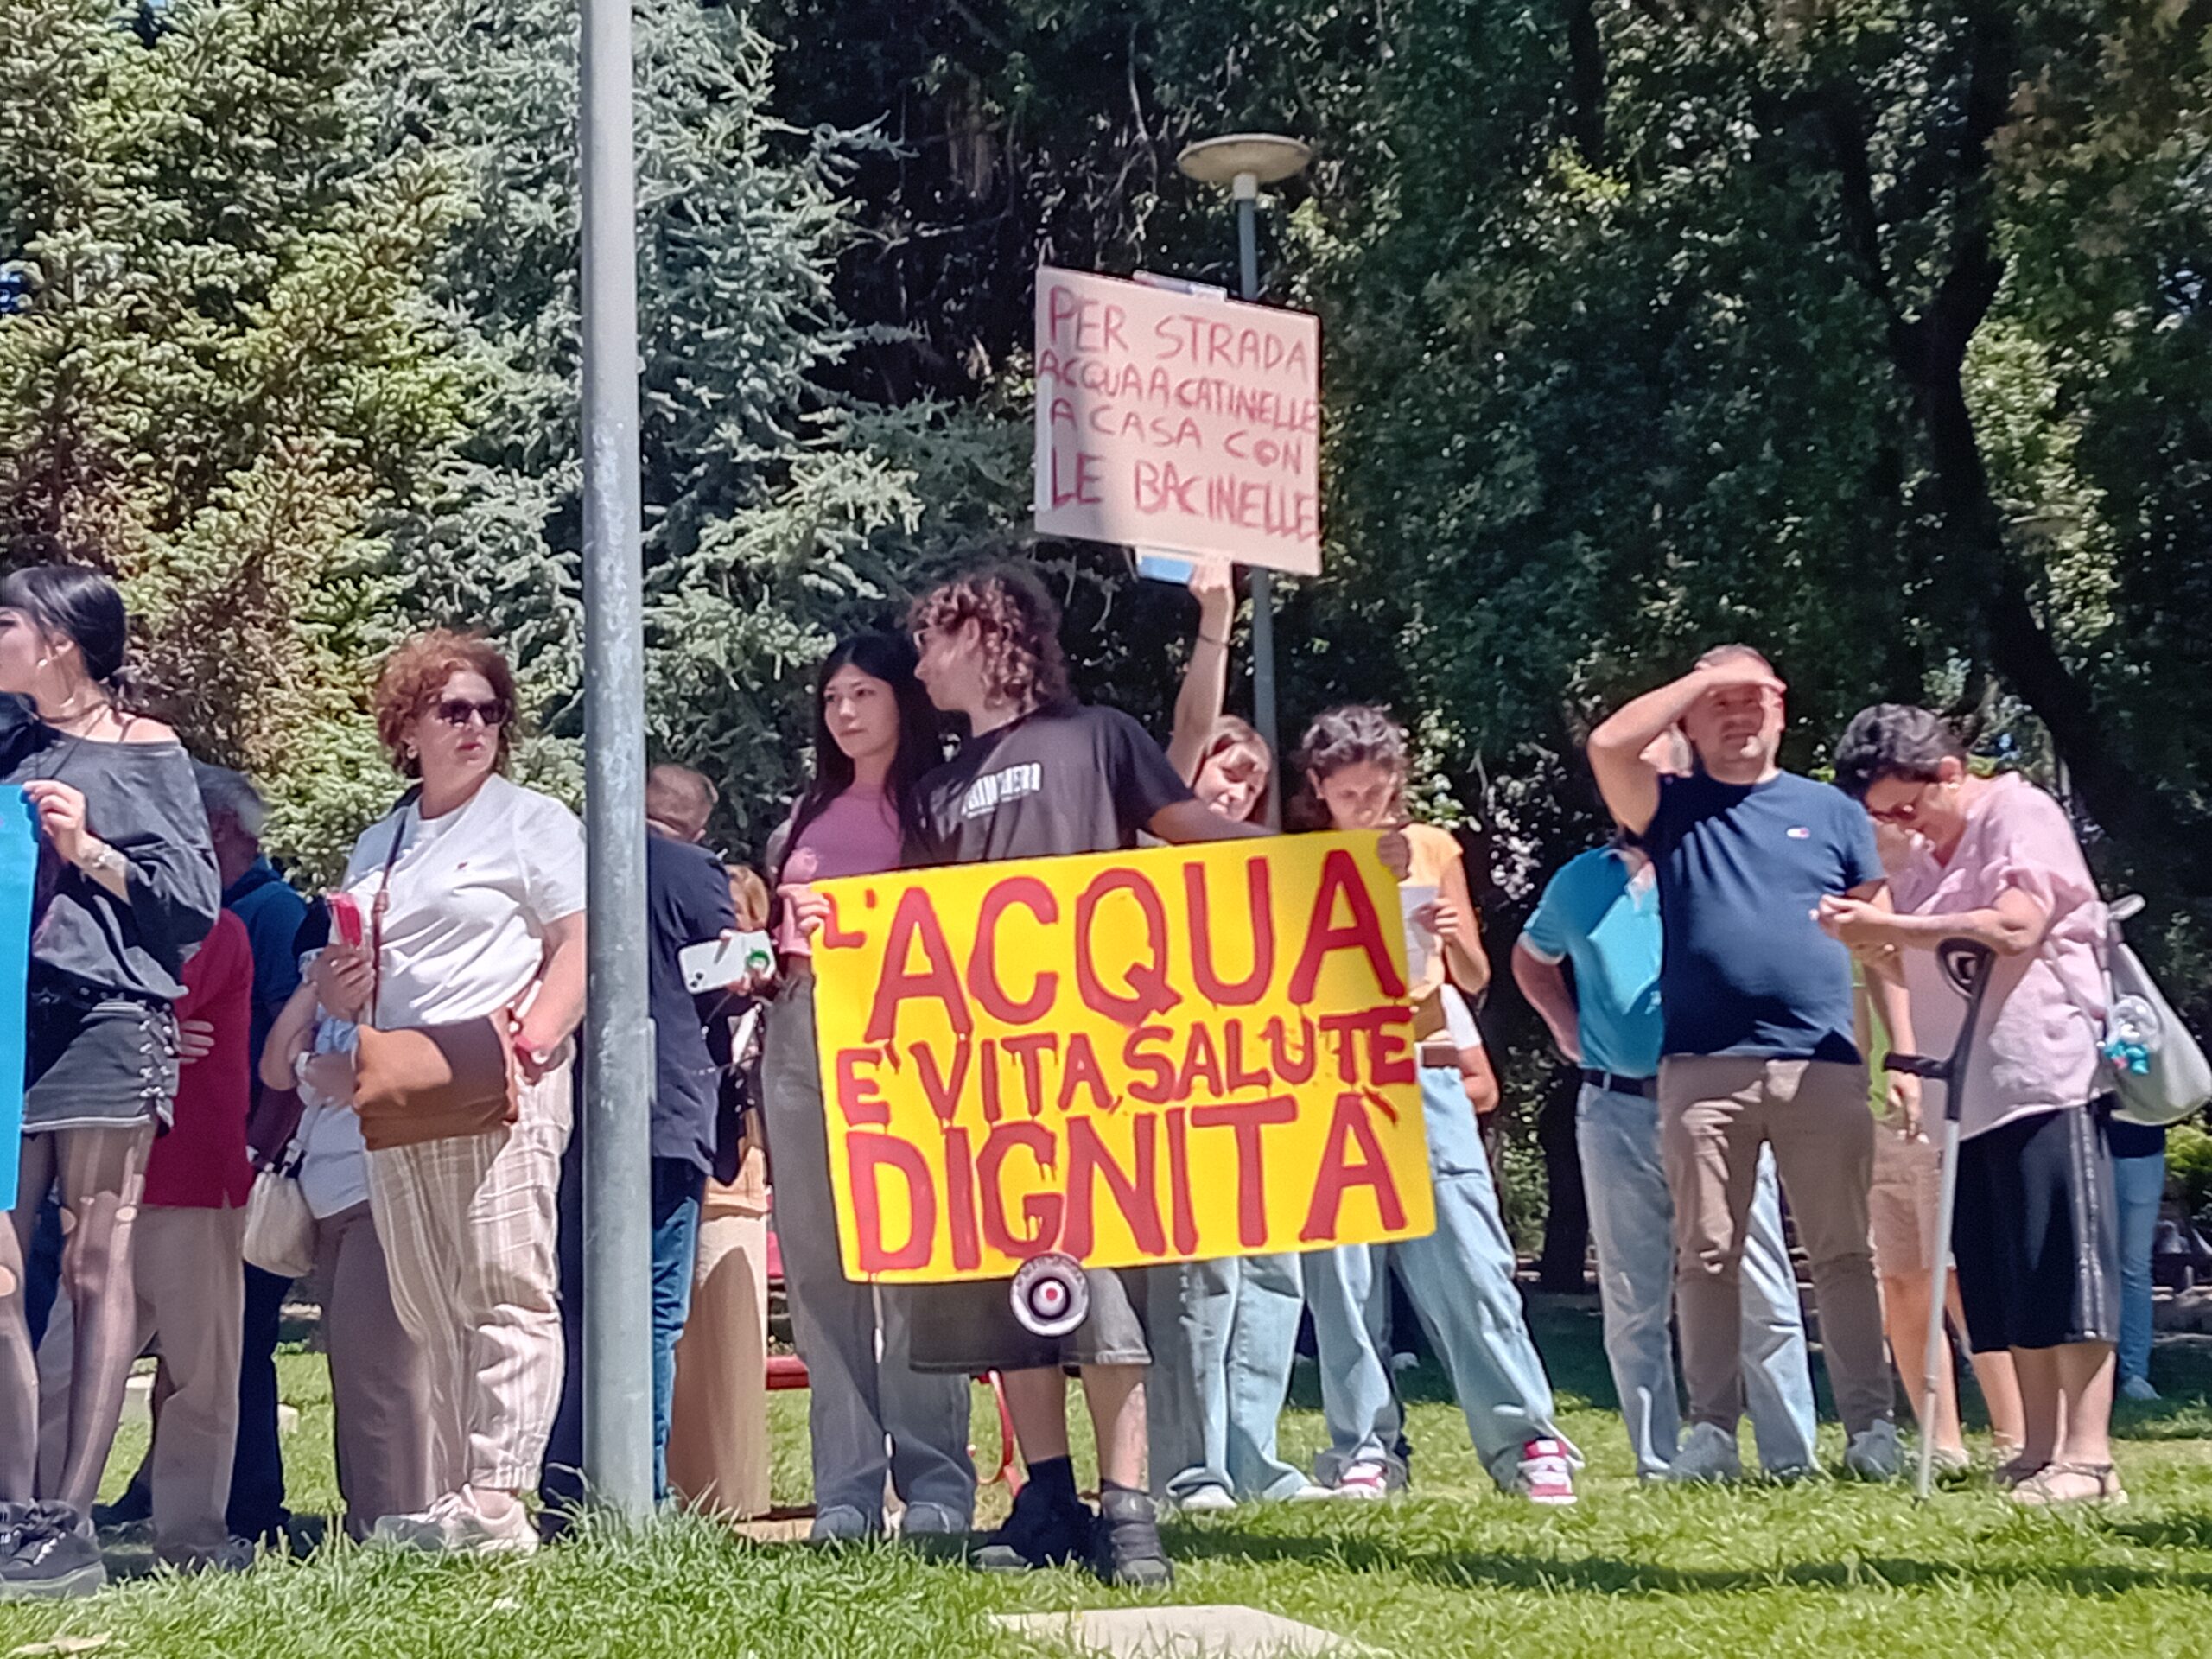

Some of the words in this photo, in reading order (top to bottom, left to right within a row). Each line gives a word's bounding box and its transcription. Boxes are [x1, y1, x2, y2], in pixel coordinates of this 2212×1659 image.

[1048, 284, 1128, 353] PER
[1155, 314, 1309, 383] STRADA
[1050, 397, 1078, 432] A
[1089, 404, 1202, 451] CASA
[1224, 430, 1303, 475] CON
[1175, 376, 1318, 435] CATINELLE
[1051, 447, 1104, 510] LE
[1134, 459, 1319, 543] BACINELLE
[822, 849, 1408, 1044] L'ACQUA
[1122, 1004, 1417, 1105] SALUTE
